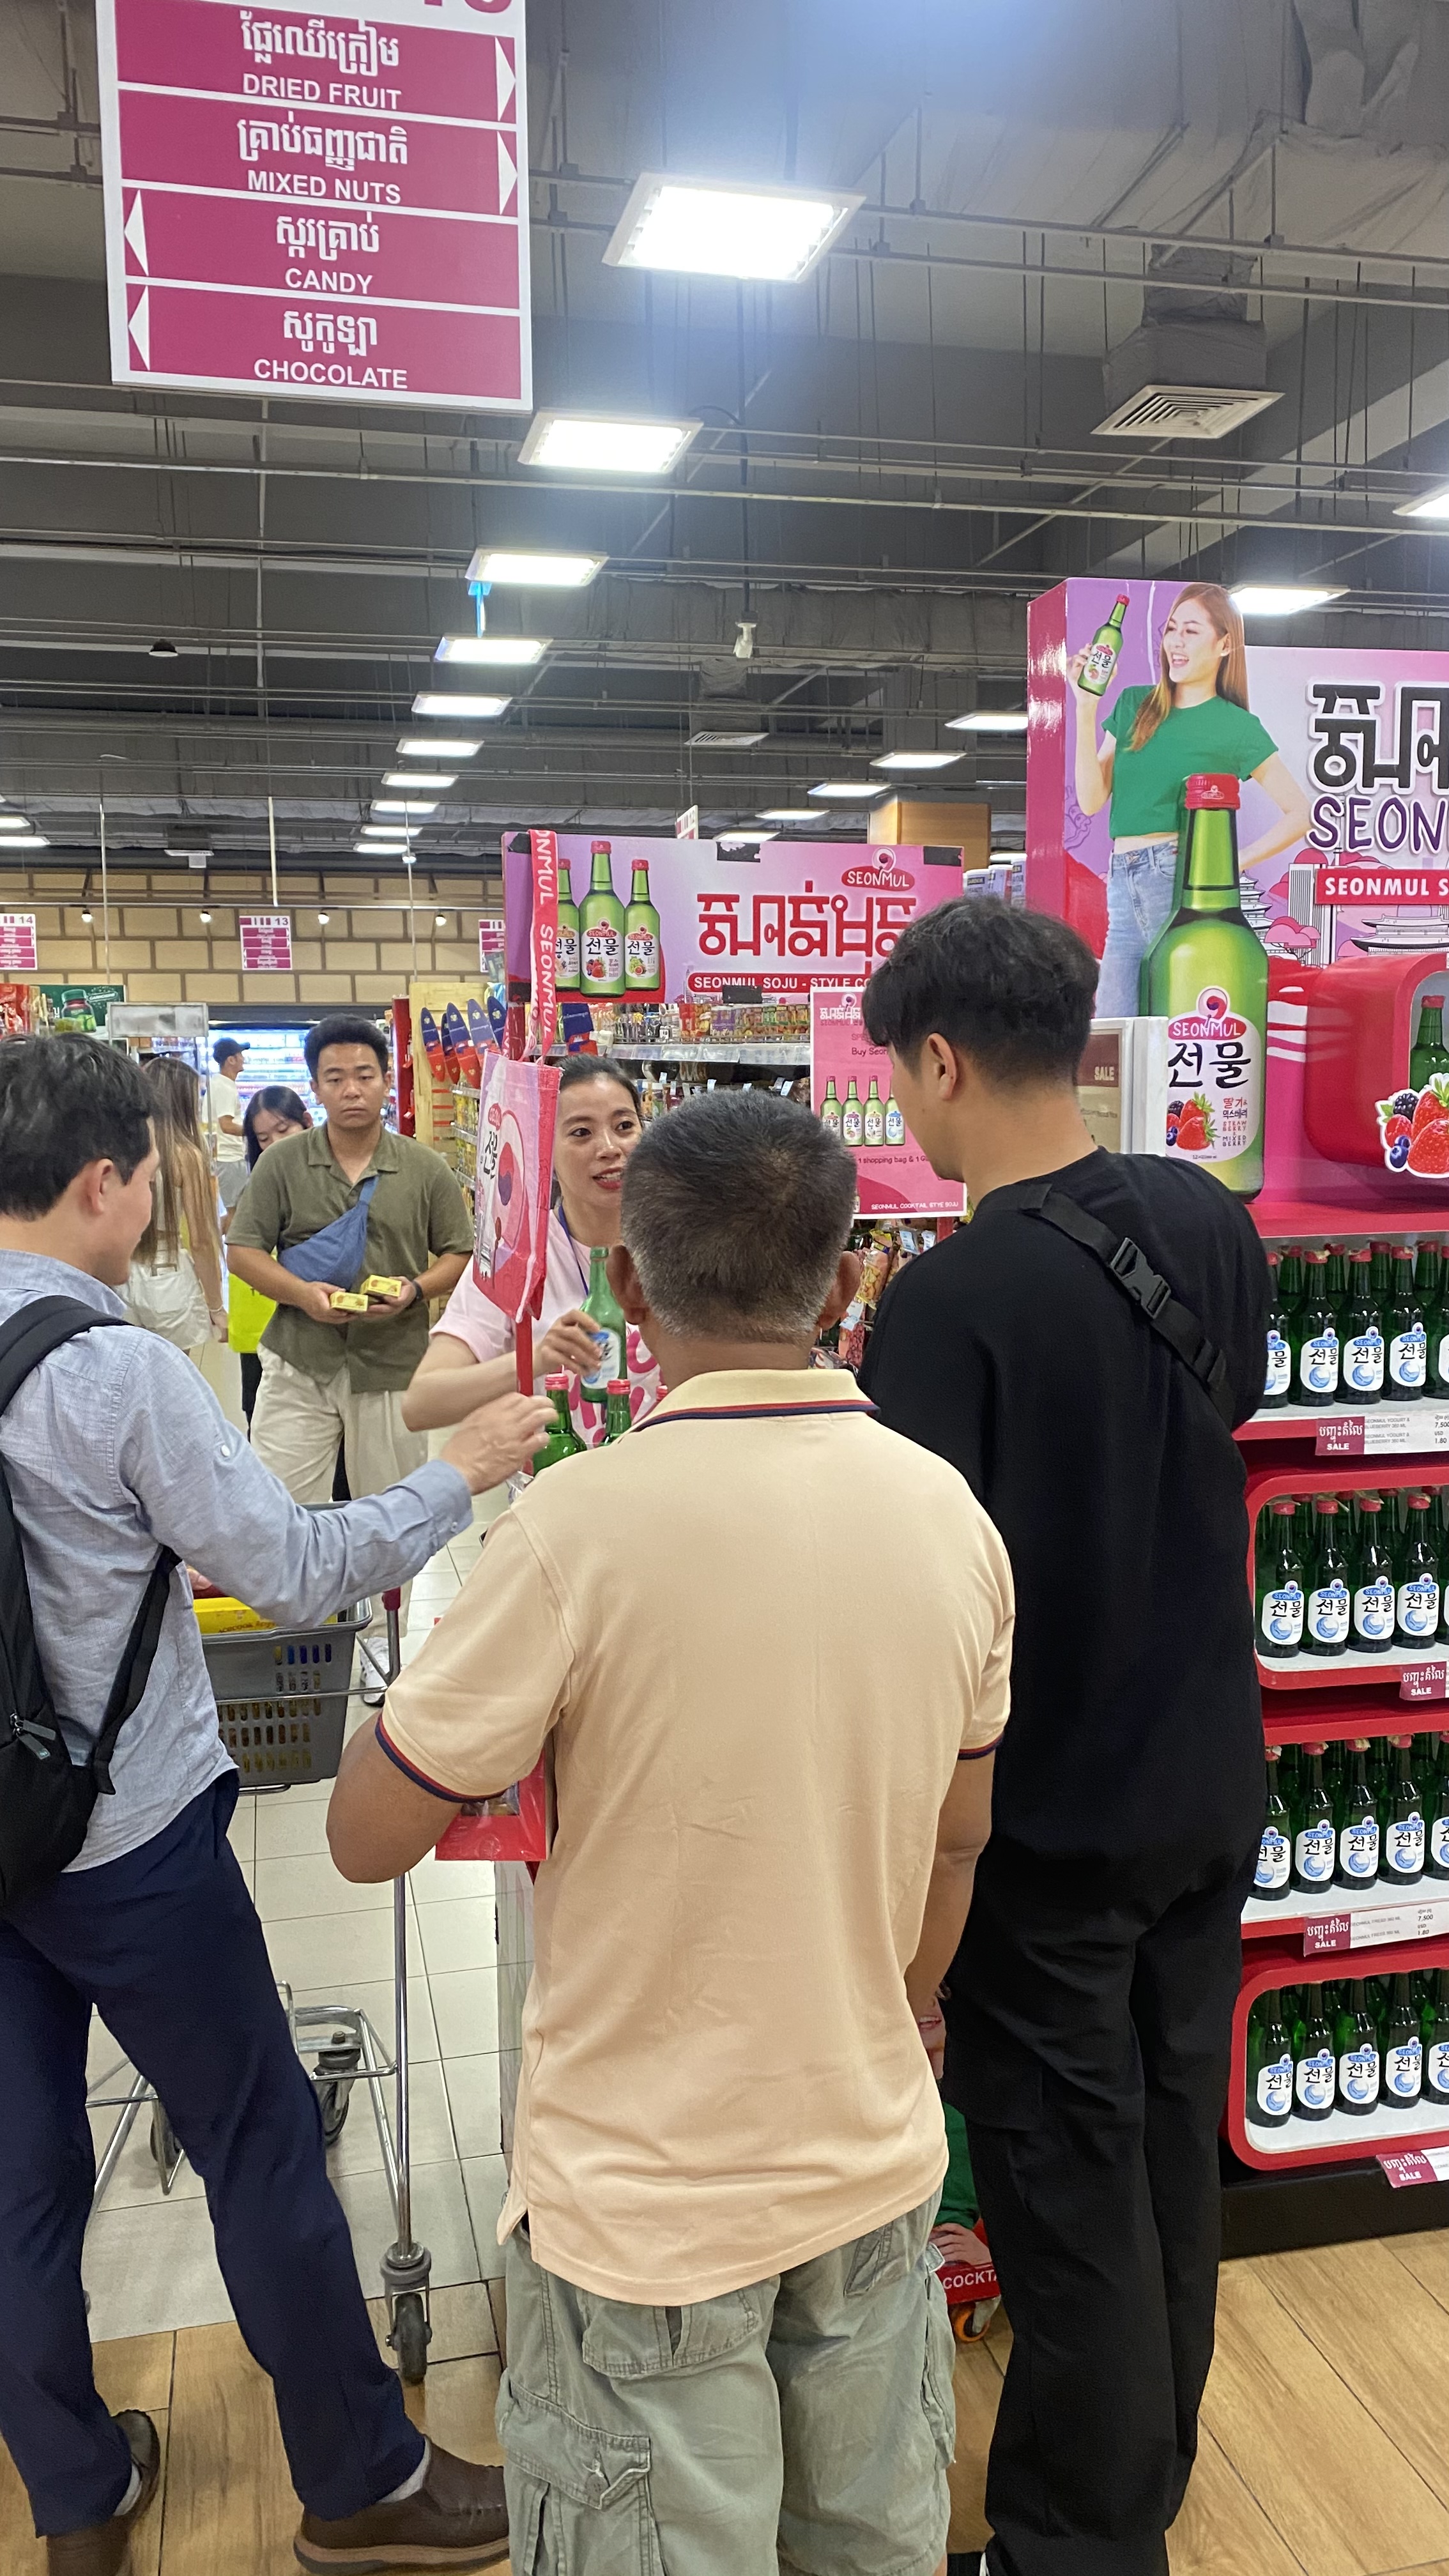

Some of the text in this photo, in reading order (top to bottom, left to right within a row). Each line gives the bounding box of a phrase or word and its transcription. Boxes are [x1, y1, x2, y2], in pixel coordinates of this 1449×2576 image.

[240, 10, 399, 77] ផ្លែឈើក្រៀម
[243, 73, 401, 110] DRIED FRUIT
[248, 169, 401, 204] MIXED NUTS
[276, 211, 379, 261] ស្ករគ្រាប់
[285, 267, 373, 294] CANDY
[284, 310, 377, 356] សូកូឡា
[254, 358, 408, 389] CHOCOLATE
[1309, 796, 1446, 851] SEON
[847, 870, 910, 888] SEONMUL
[1325, 877, 1449, 896] SEONMUL S
[19, 916, 33, 924] 14
[540, 924, 555, 1038] SEONMUL
[763, 977, 797, 988] SOJU
[810, 977, 850, 988] STYLE
[854, 978, 870, 988] CO
[1173, 1019, 1241, 1038] SEONMUL
[852, 1047, 888, 1057] Buy Seon
[1094, 1066, 1116, 1081] SALE
[1411, 1687, 1432, 1696] SALE
[1315, 1940, 1336, 1948] SALE
[1399, 2171, 1422, 2181] SALE
